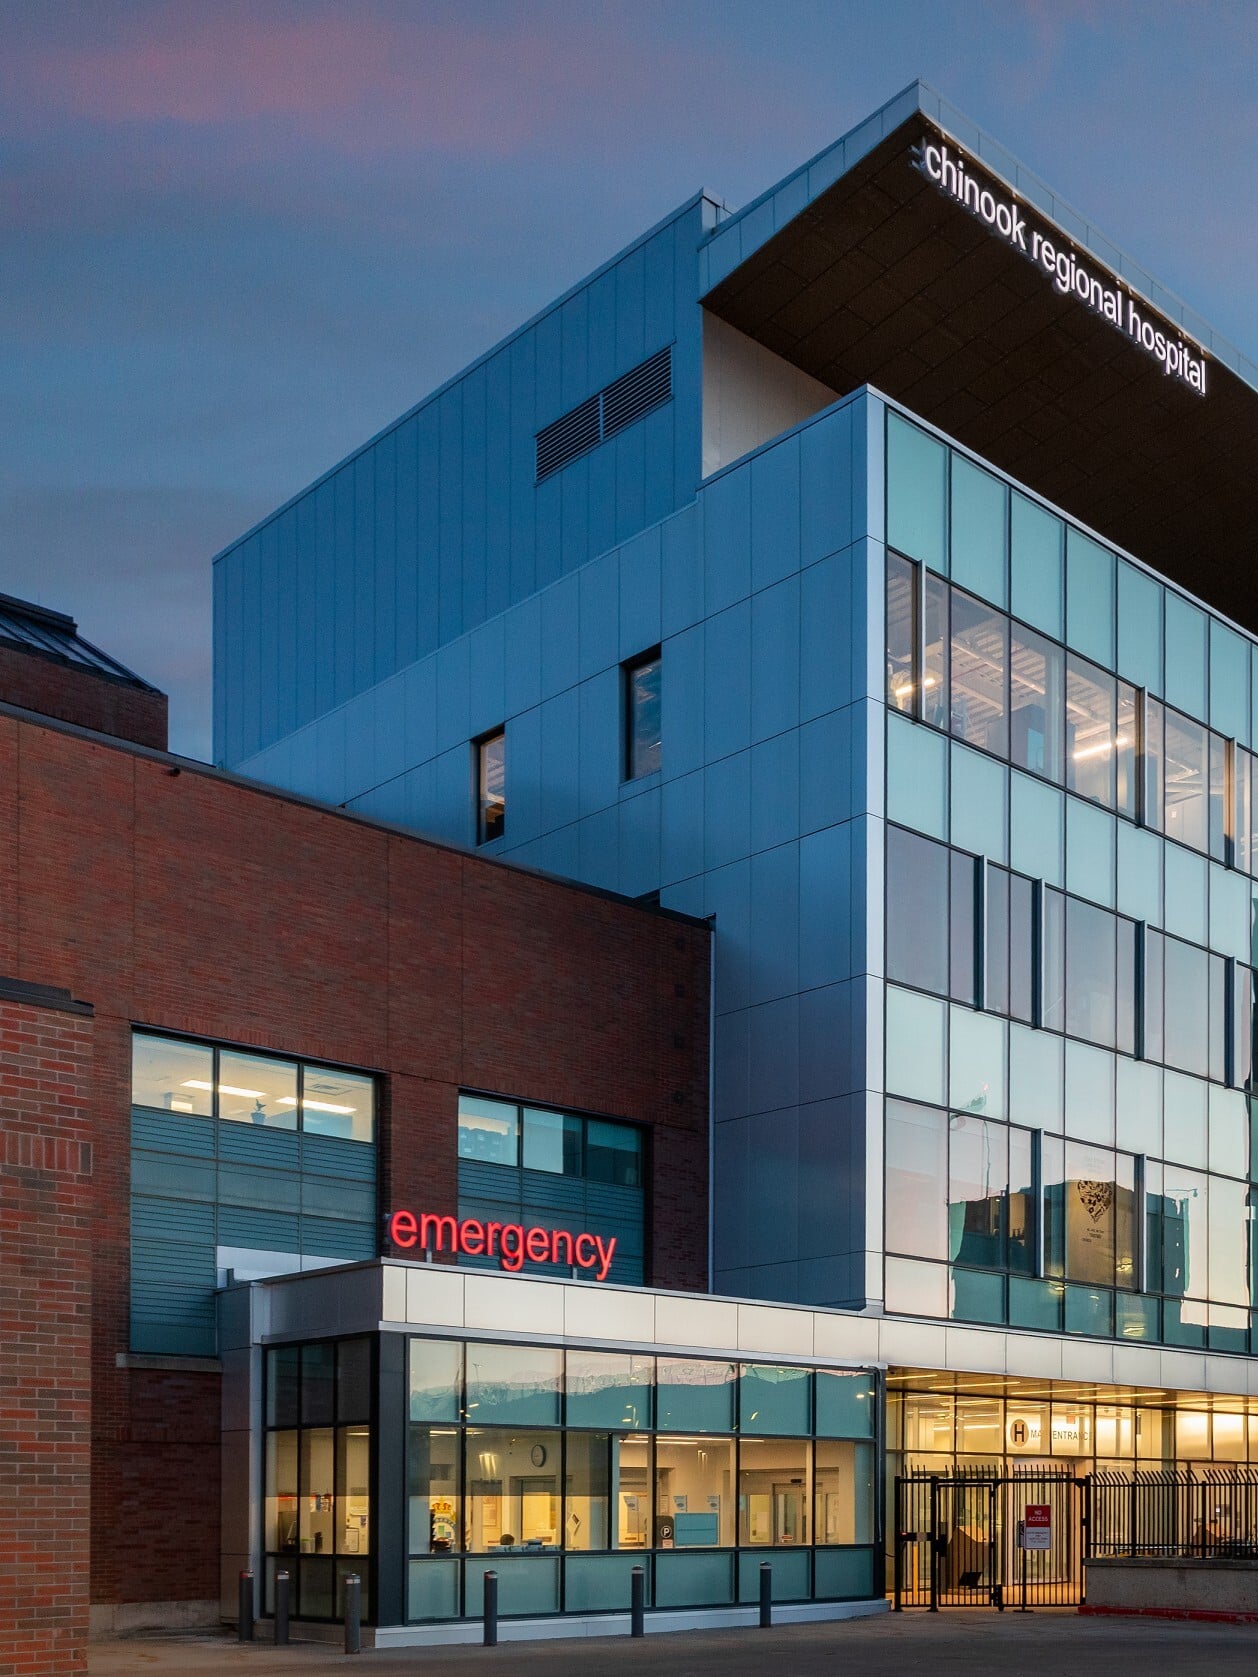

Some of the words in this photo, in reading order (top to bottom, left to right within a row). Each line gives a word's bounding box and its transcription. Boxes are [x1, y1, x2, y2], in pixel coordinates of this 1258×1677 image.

[925, 145, 1026, 250] chinook
[1032, 230, 1123, 327] regional
[1128, 300, 1206, 394] hospital
[390, 1209, 617, 1281] emergency
[1014, 1424, 1025, 1442] H
